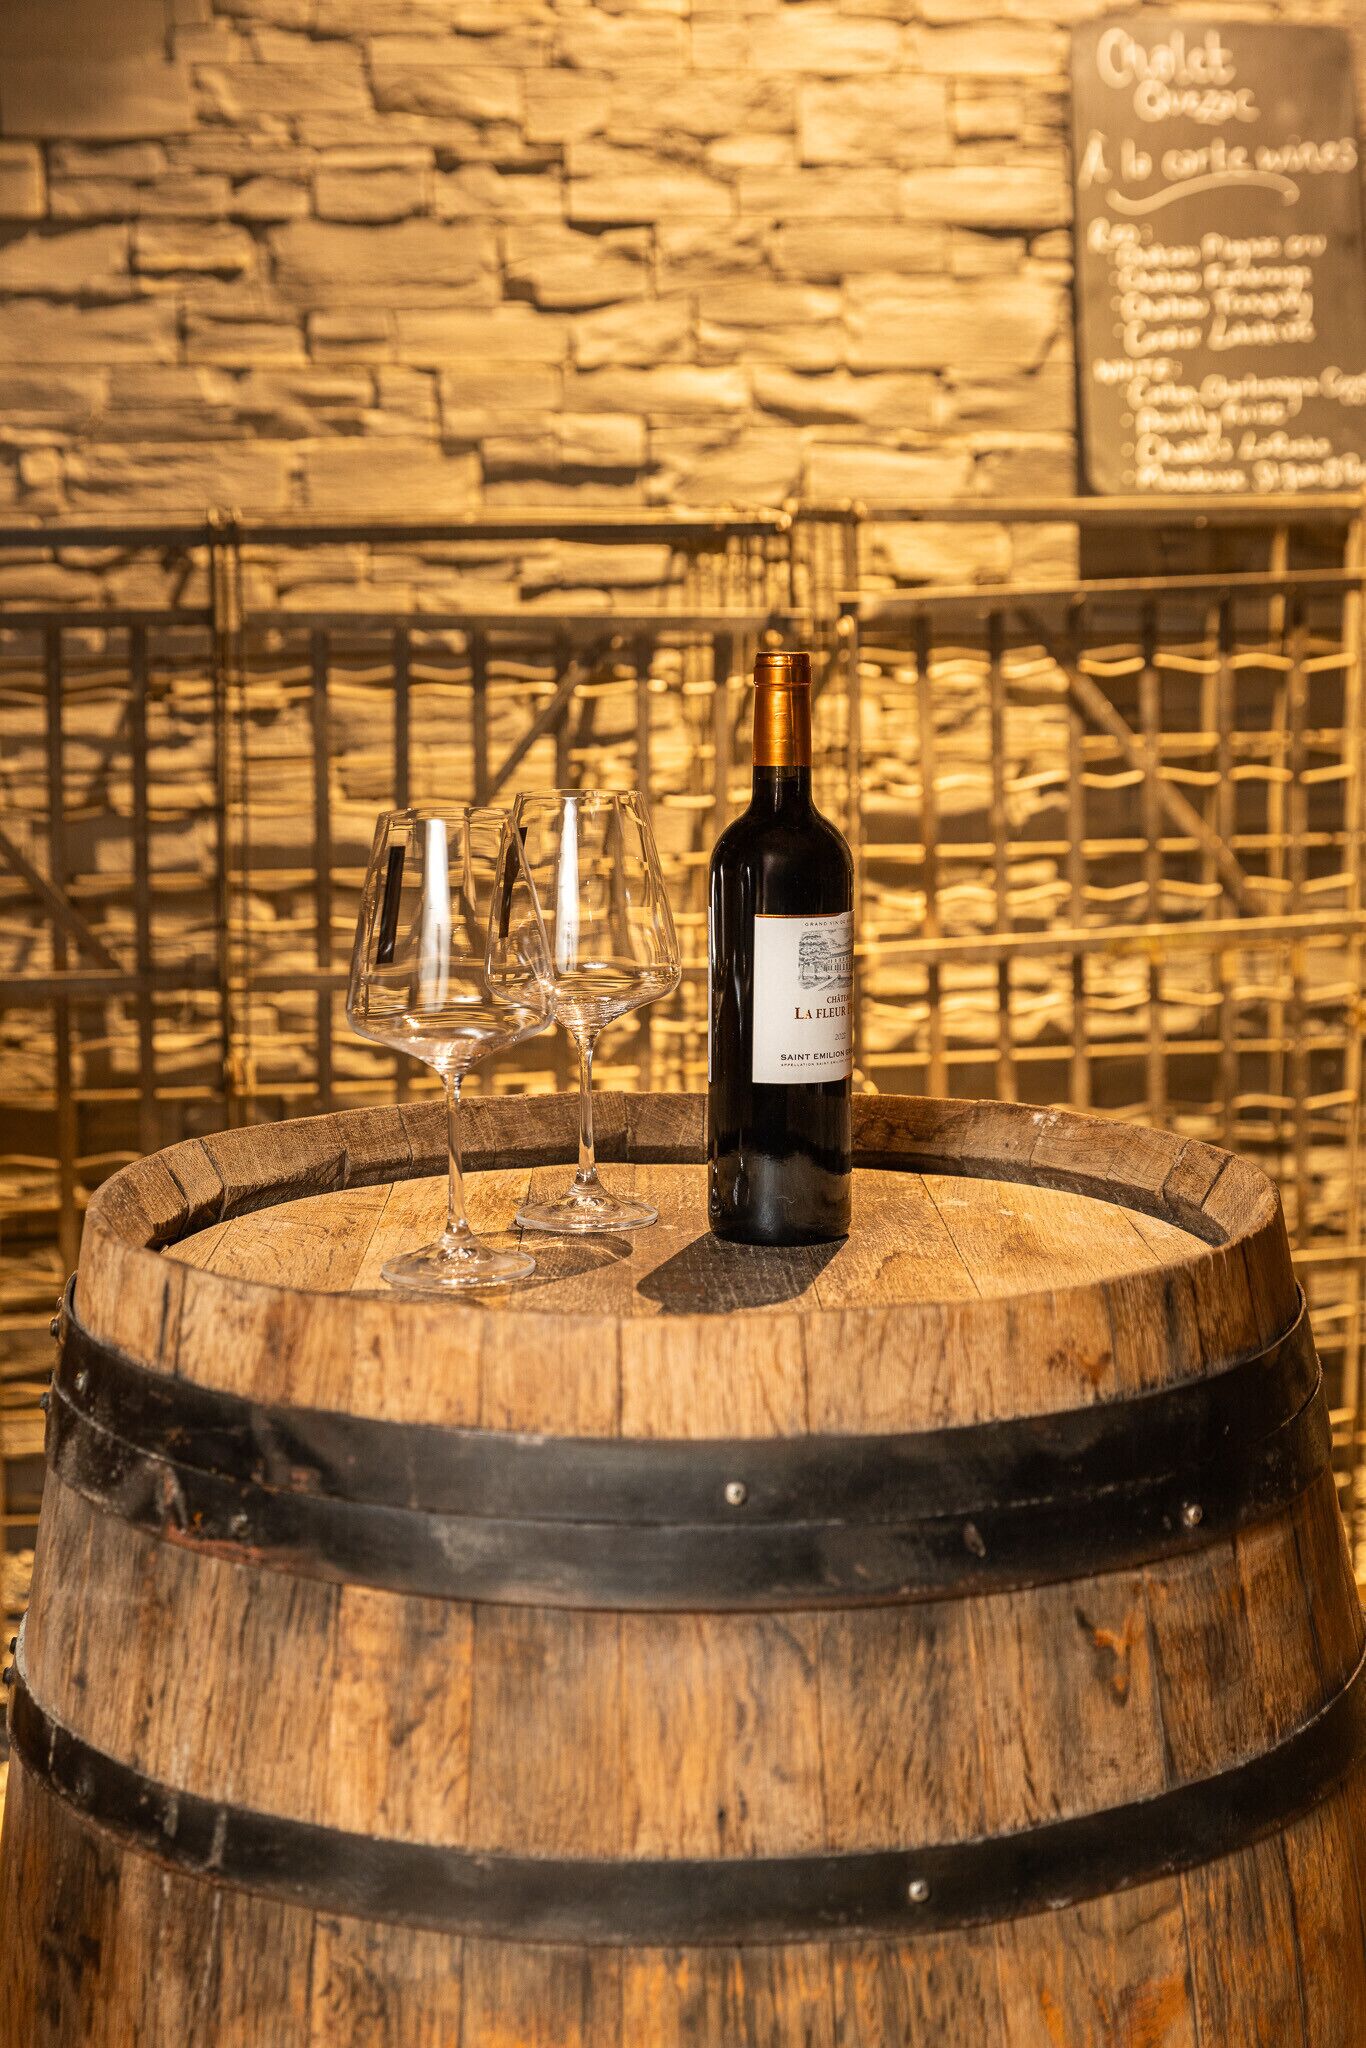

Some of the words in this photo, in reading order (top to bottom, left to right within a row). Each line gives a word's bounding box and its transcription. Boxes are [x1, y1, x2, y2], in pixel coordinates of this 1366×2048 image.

[816, 1005, 847, 1019] FLEUR
[780, 1053, 811, 1061] SAINT
[813, 1050, 845, 1060] EMILION
